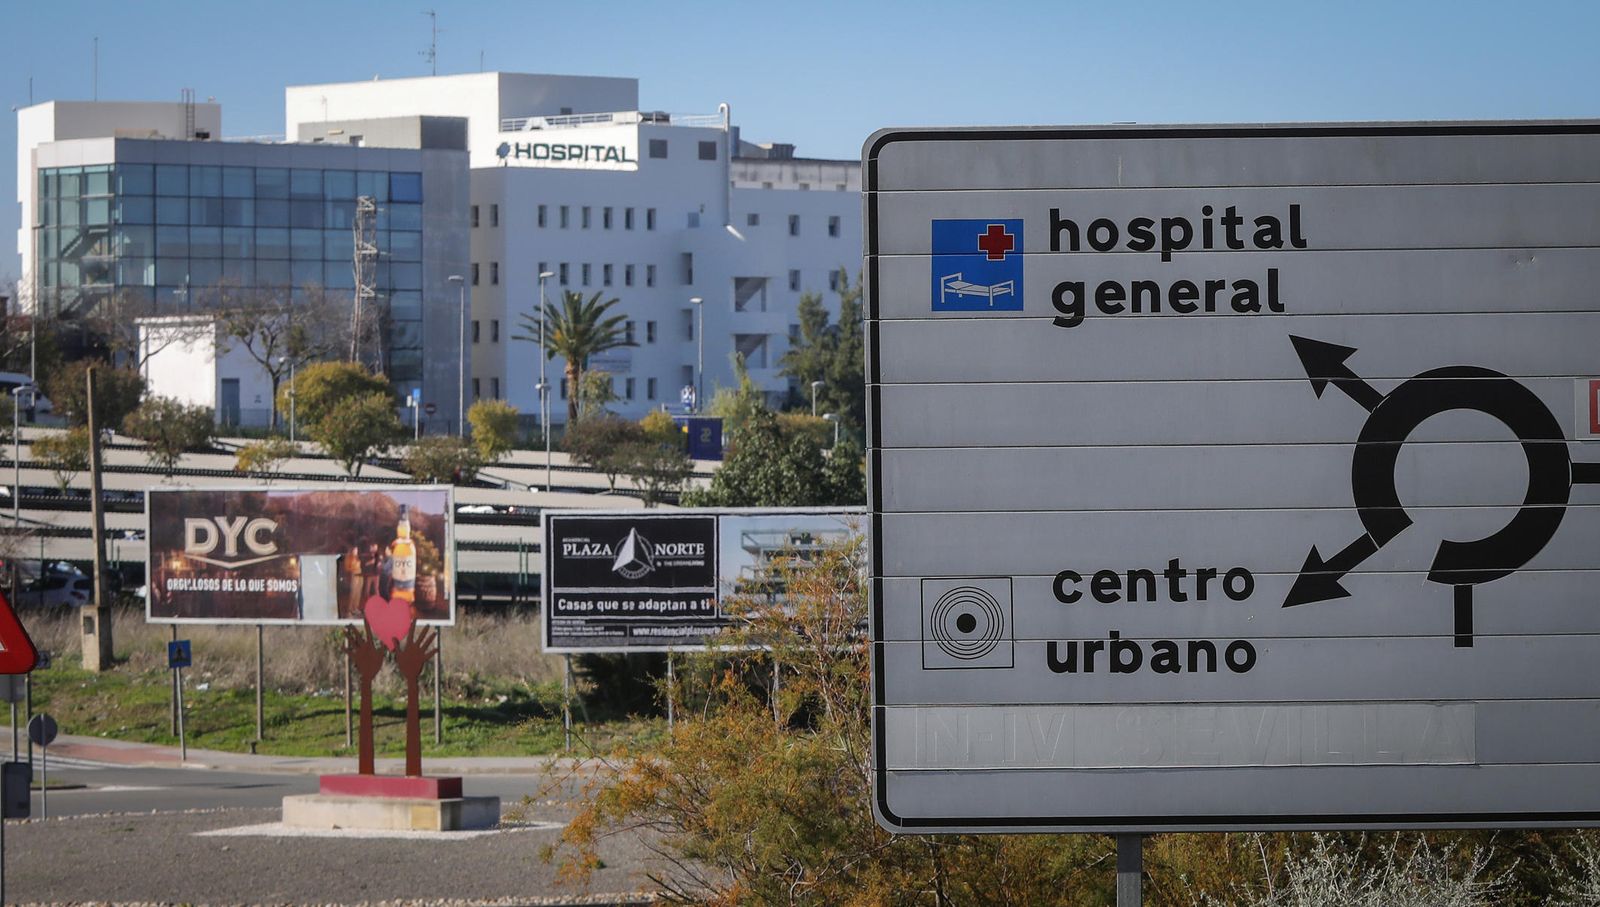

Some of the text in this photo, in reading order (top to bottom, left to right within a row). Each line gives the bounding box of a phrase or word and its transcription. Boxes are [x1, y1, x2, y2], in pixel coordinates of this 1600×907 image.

[515, 142, 638, 163] HOSPITAL
[1050, 205, 1307, 262] hospital
[1052, 268, 1285, 327] general
[184, 516, 279, 557] DYC
[563, 543, 705, 556] PLAZA NORTE
[222, 578, 233, 592] DE
[235, 579, 247, 592] LO
[248, 579, 265, 592] QUE
[266, 579, 298, 593] SOMOS
[1052, 558, 1255, 604] centro
[558, 599, 710, 613] Casas que se adaptan a ti
[1047, 630, 1257, 674] urbano
